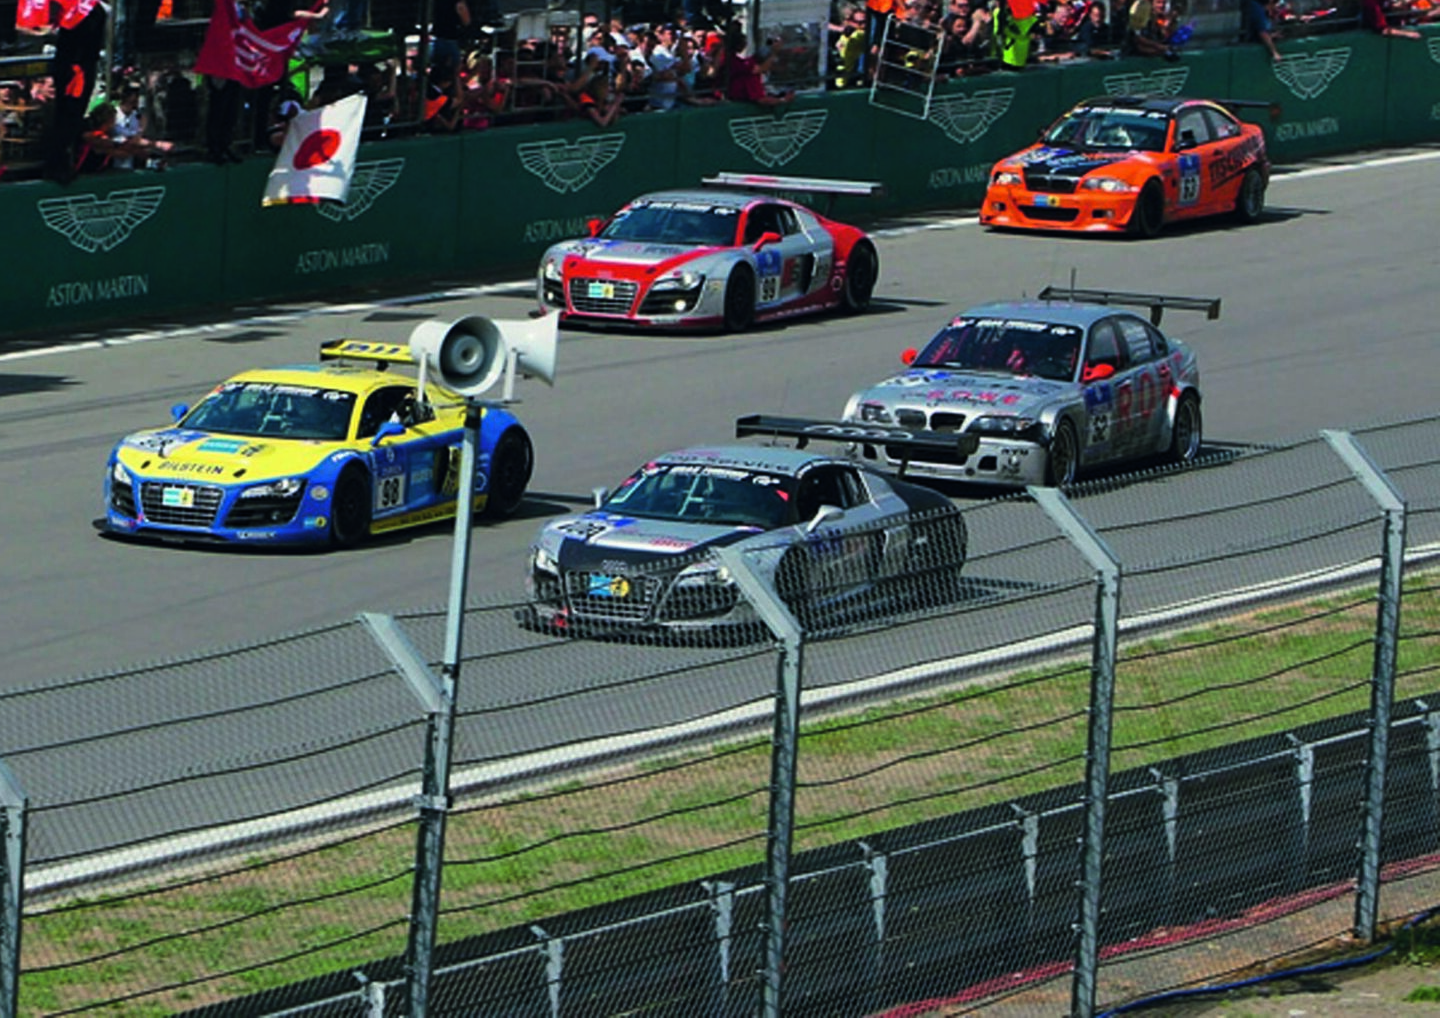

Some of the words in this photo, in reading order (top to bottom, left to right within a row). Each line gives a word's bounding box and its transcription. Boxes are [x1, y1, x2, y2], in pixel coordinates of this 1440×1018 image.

[295, 248, 339, 274] ASTON
[341, 242, 389, 268] MARTIN
[46, 282, 94, 308] ASTON
[96, 274, 149, 301] MARTIN
